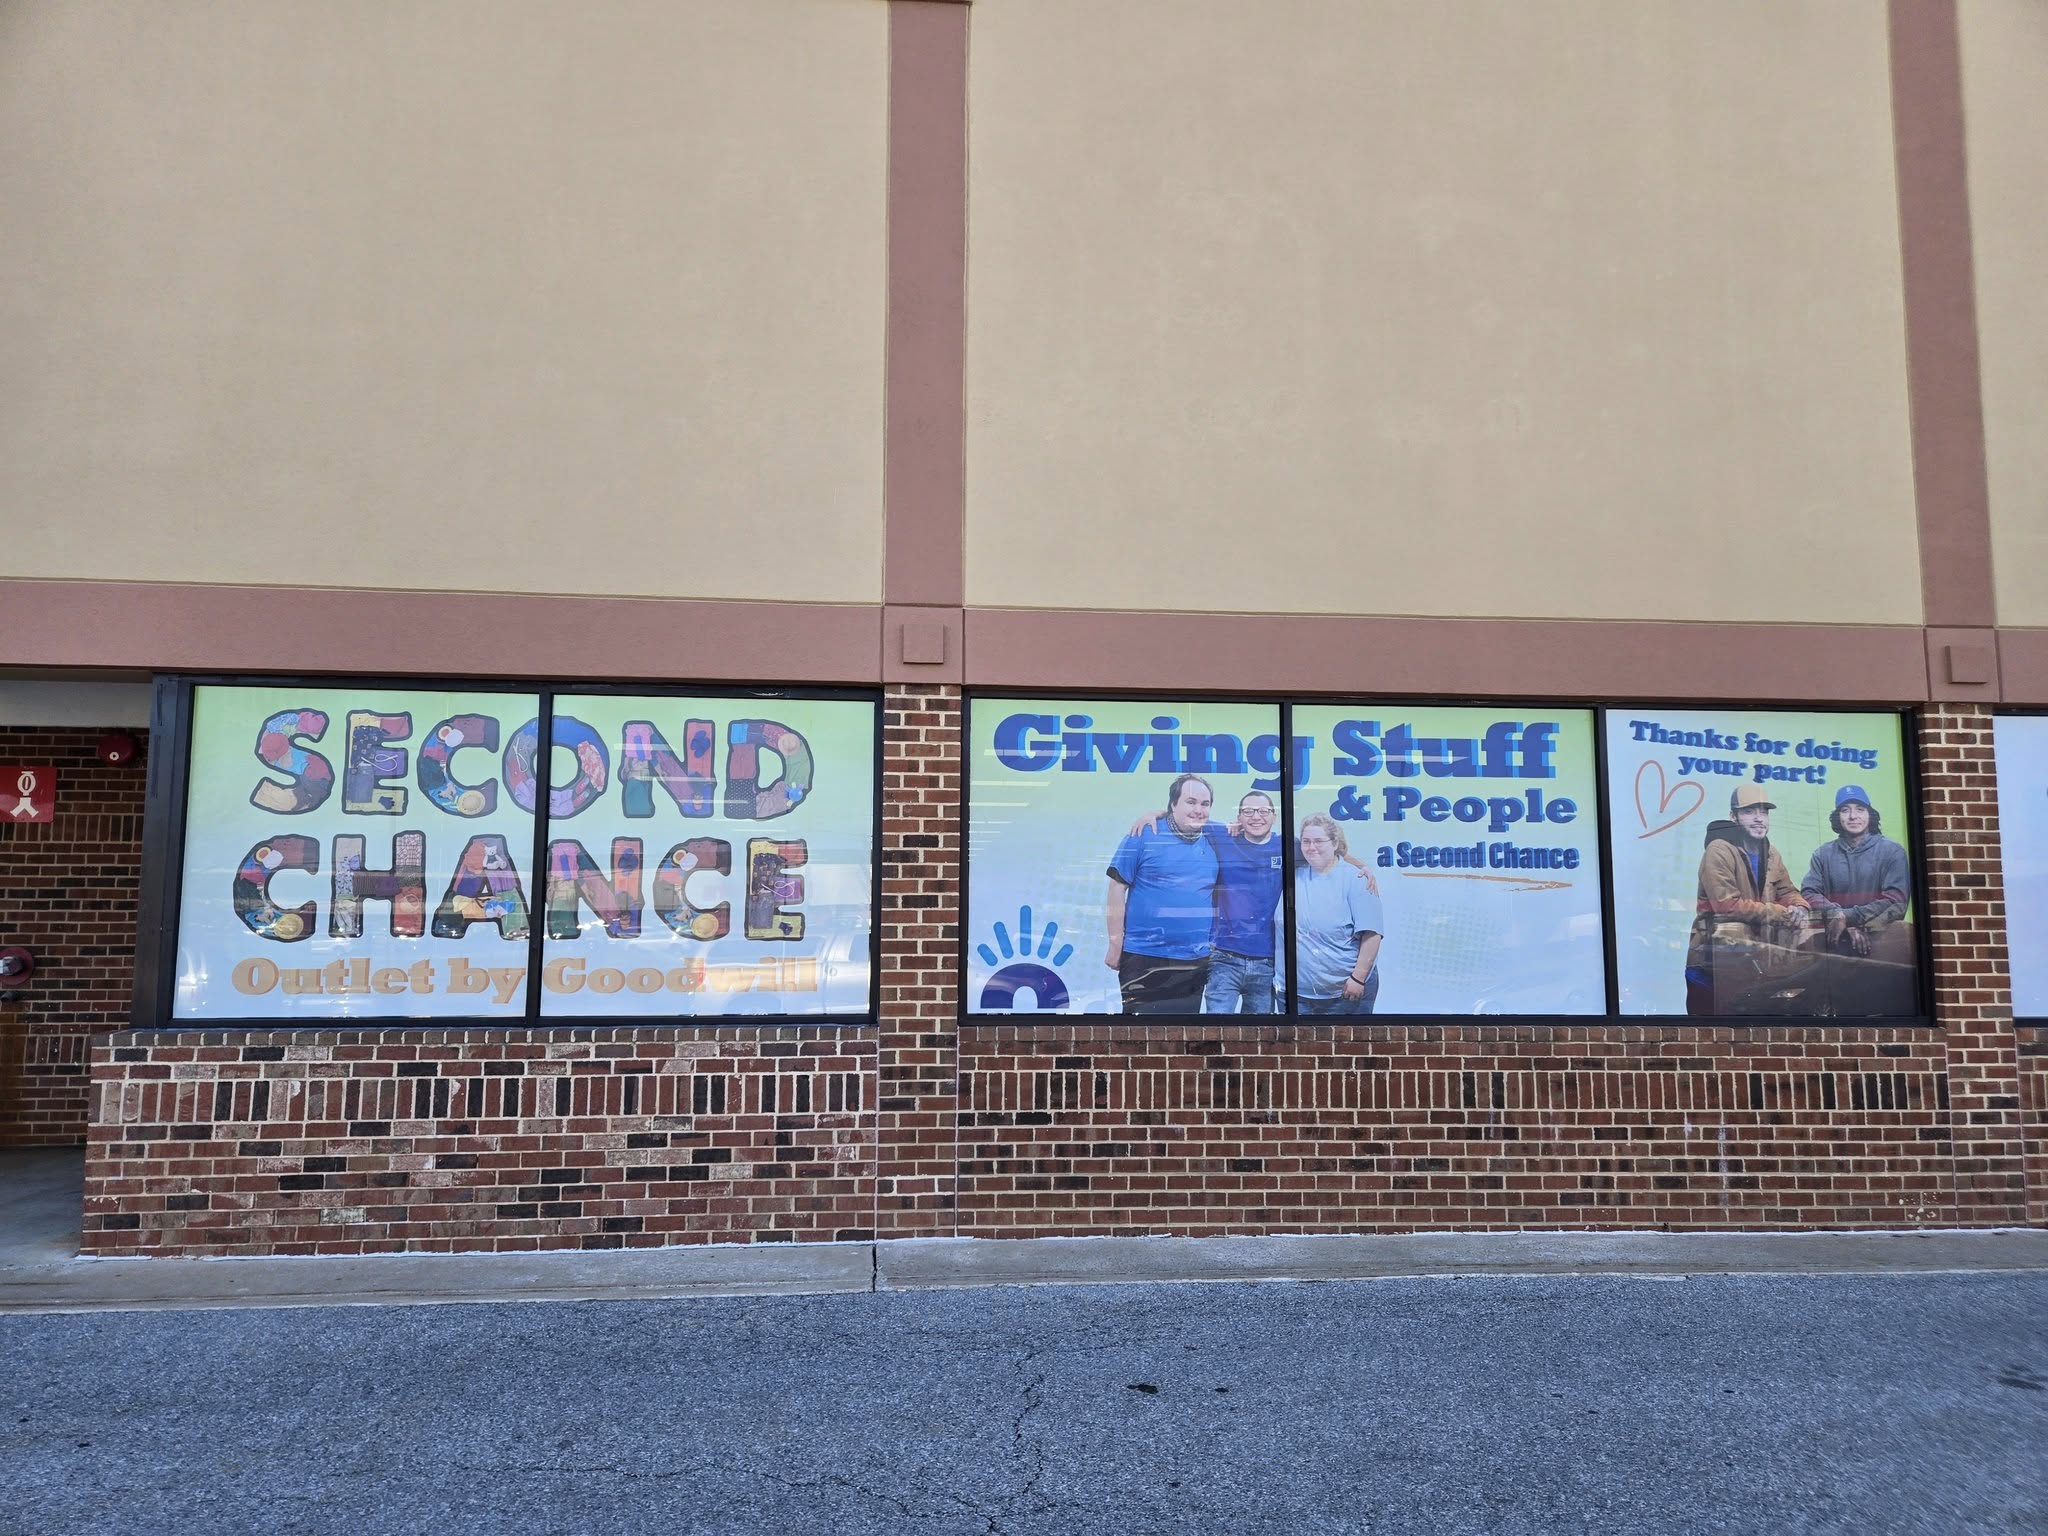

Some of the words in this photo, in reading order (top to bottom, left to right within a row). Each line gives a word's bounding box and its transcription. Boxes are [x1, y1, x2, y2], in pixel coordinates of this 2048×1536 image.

[249, 707, 815, 820] SECOND
[993, 713, 1314, 791] Giving
[1333, 719, 1560, 779] Stuff
[1629, 719, 1739, 752] Thanks
[1744, 732, 1790, 756] for
[1795, 737, 1878, 770] doing
[1678, 753, 1748, 777] your
[1752, 762, 1827, 785] part!
[1329, 785, 1371, 822] &
[1383, 786, 1577, 833] People
[1377, 848, 1395, 868] a
[1396, 842, 1486, 869] Second
[1489, 842, 1579, 870] Chance
[232, 829, 809, 941] CHANCE
[231, 957, 435, 996] Outlet
[446, 956, 526, 1004] by
[543, 956, 819, 995] Goodwill
